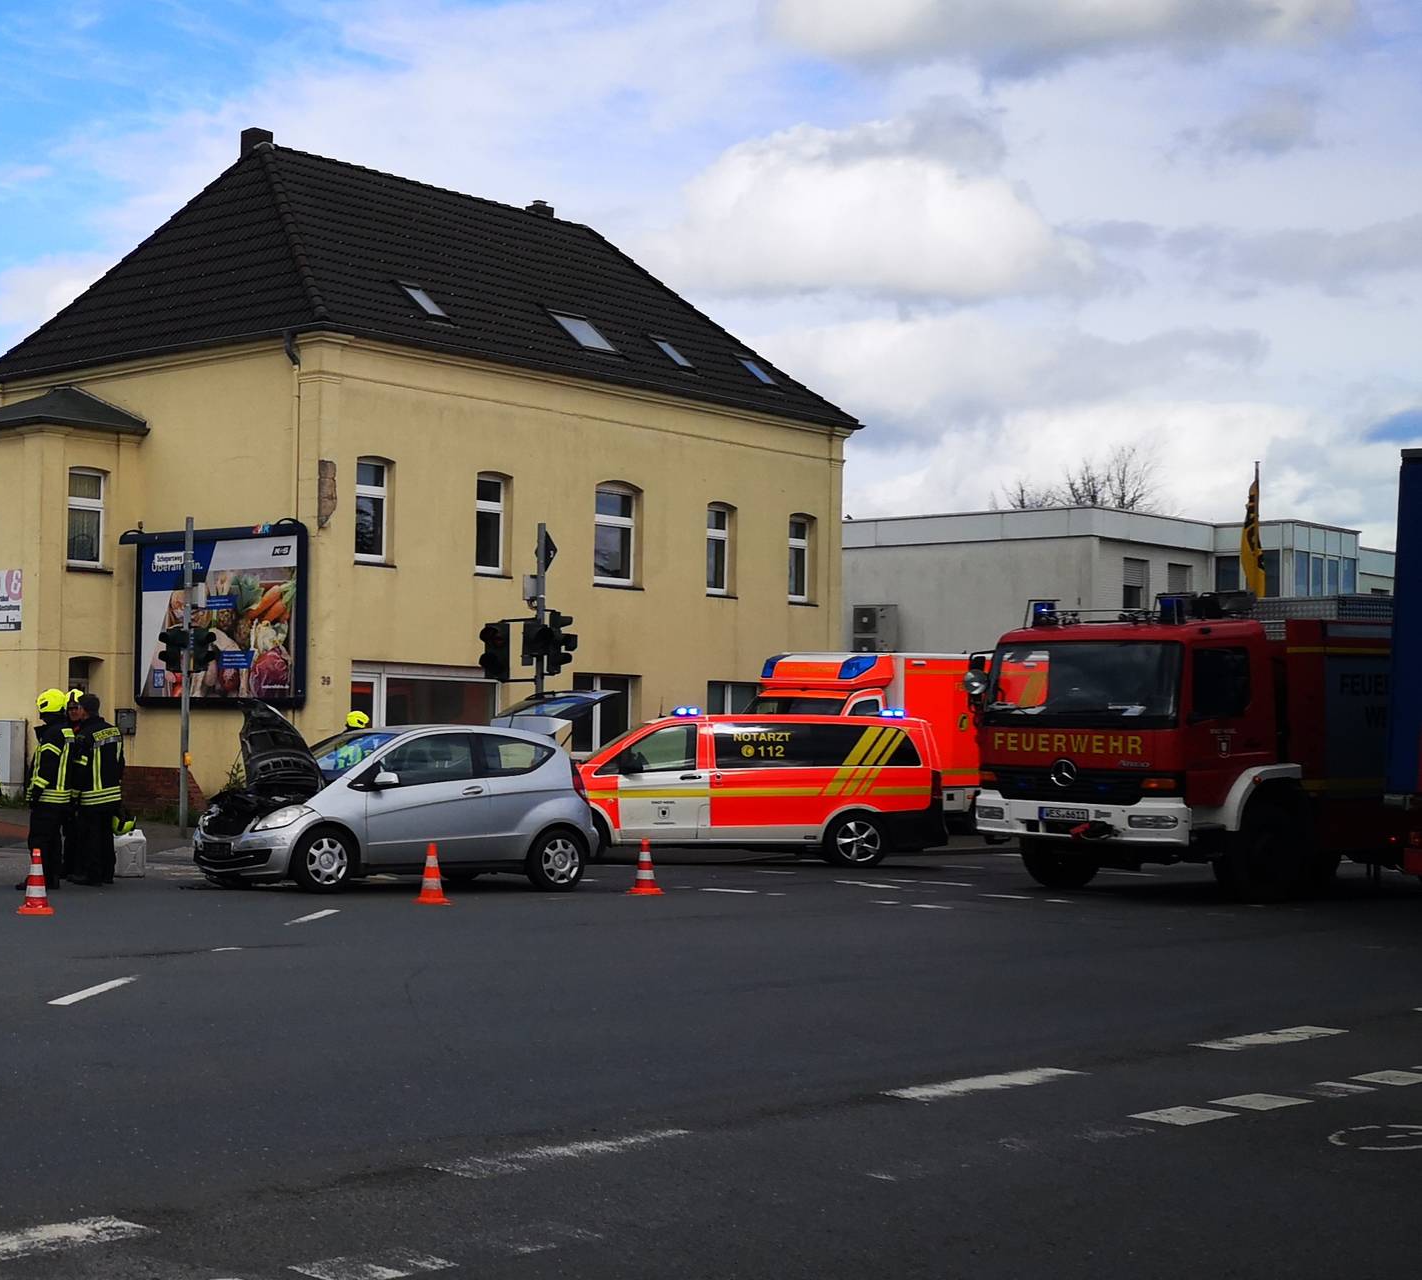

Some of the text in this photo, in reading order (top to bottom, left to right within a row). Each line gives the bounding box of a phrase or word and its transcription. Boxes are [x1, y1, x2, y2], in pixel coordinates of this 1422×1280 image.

[1339, 672, 1391, 696] FEUE
[733, 732, 791, 742] NOTARZT
[994, 732, 1143, 755] FEUERWEHR
[758, 745, 785, 757] 112
